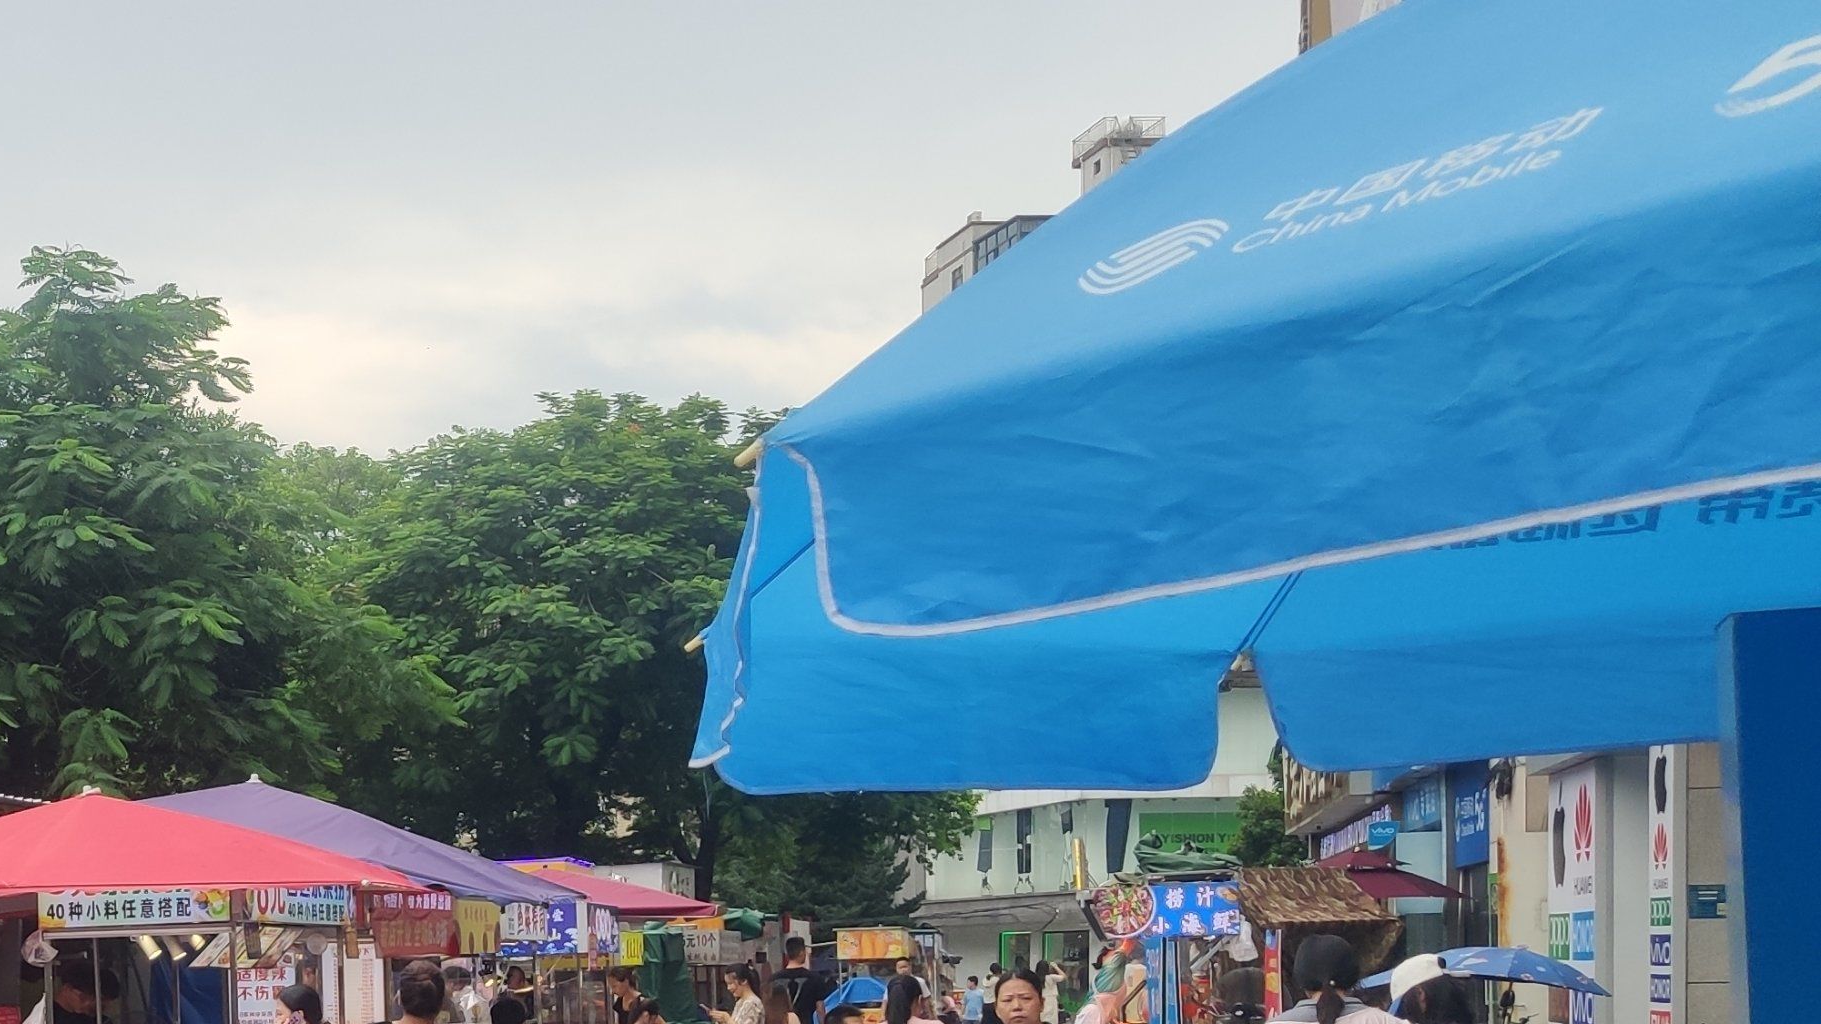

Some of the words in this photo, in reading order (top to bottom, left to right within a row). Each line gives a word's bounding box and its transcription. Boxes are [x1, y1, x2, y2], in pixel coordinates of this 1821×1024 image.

[1232, 204, 1372, 252] China
[1381, 149, 1561, 213] Mobile
[1263, 107, 1603, 221] 中国移动
[47, 898, 191, 921] 40种小料任意搭配
